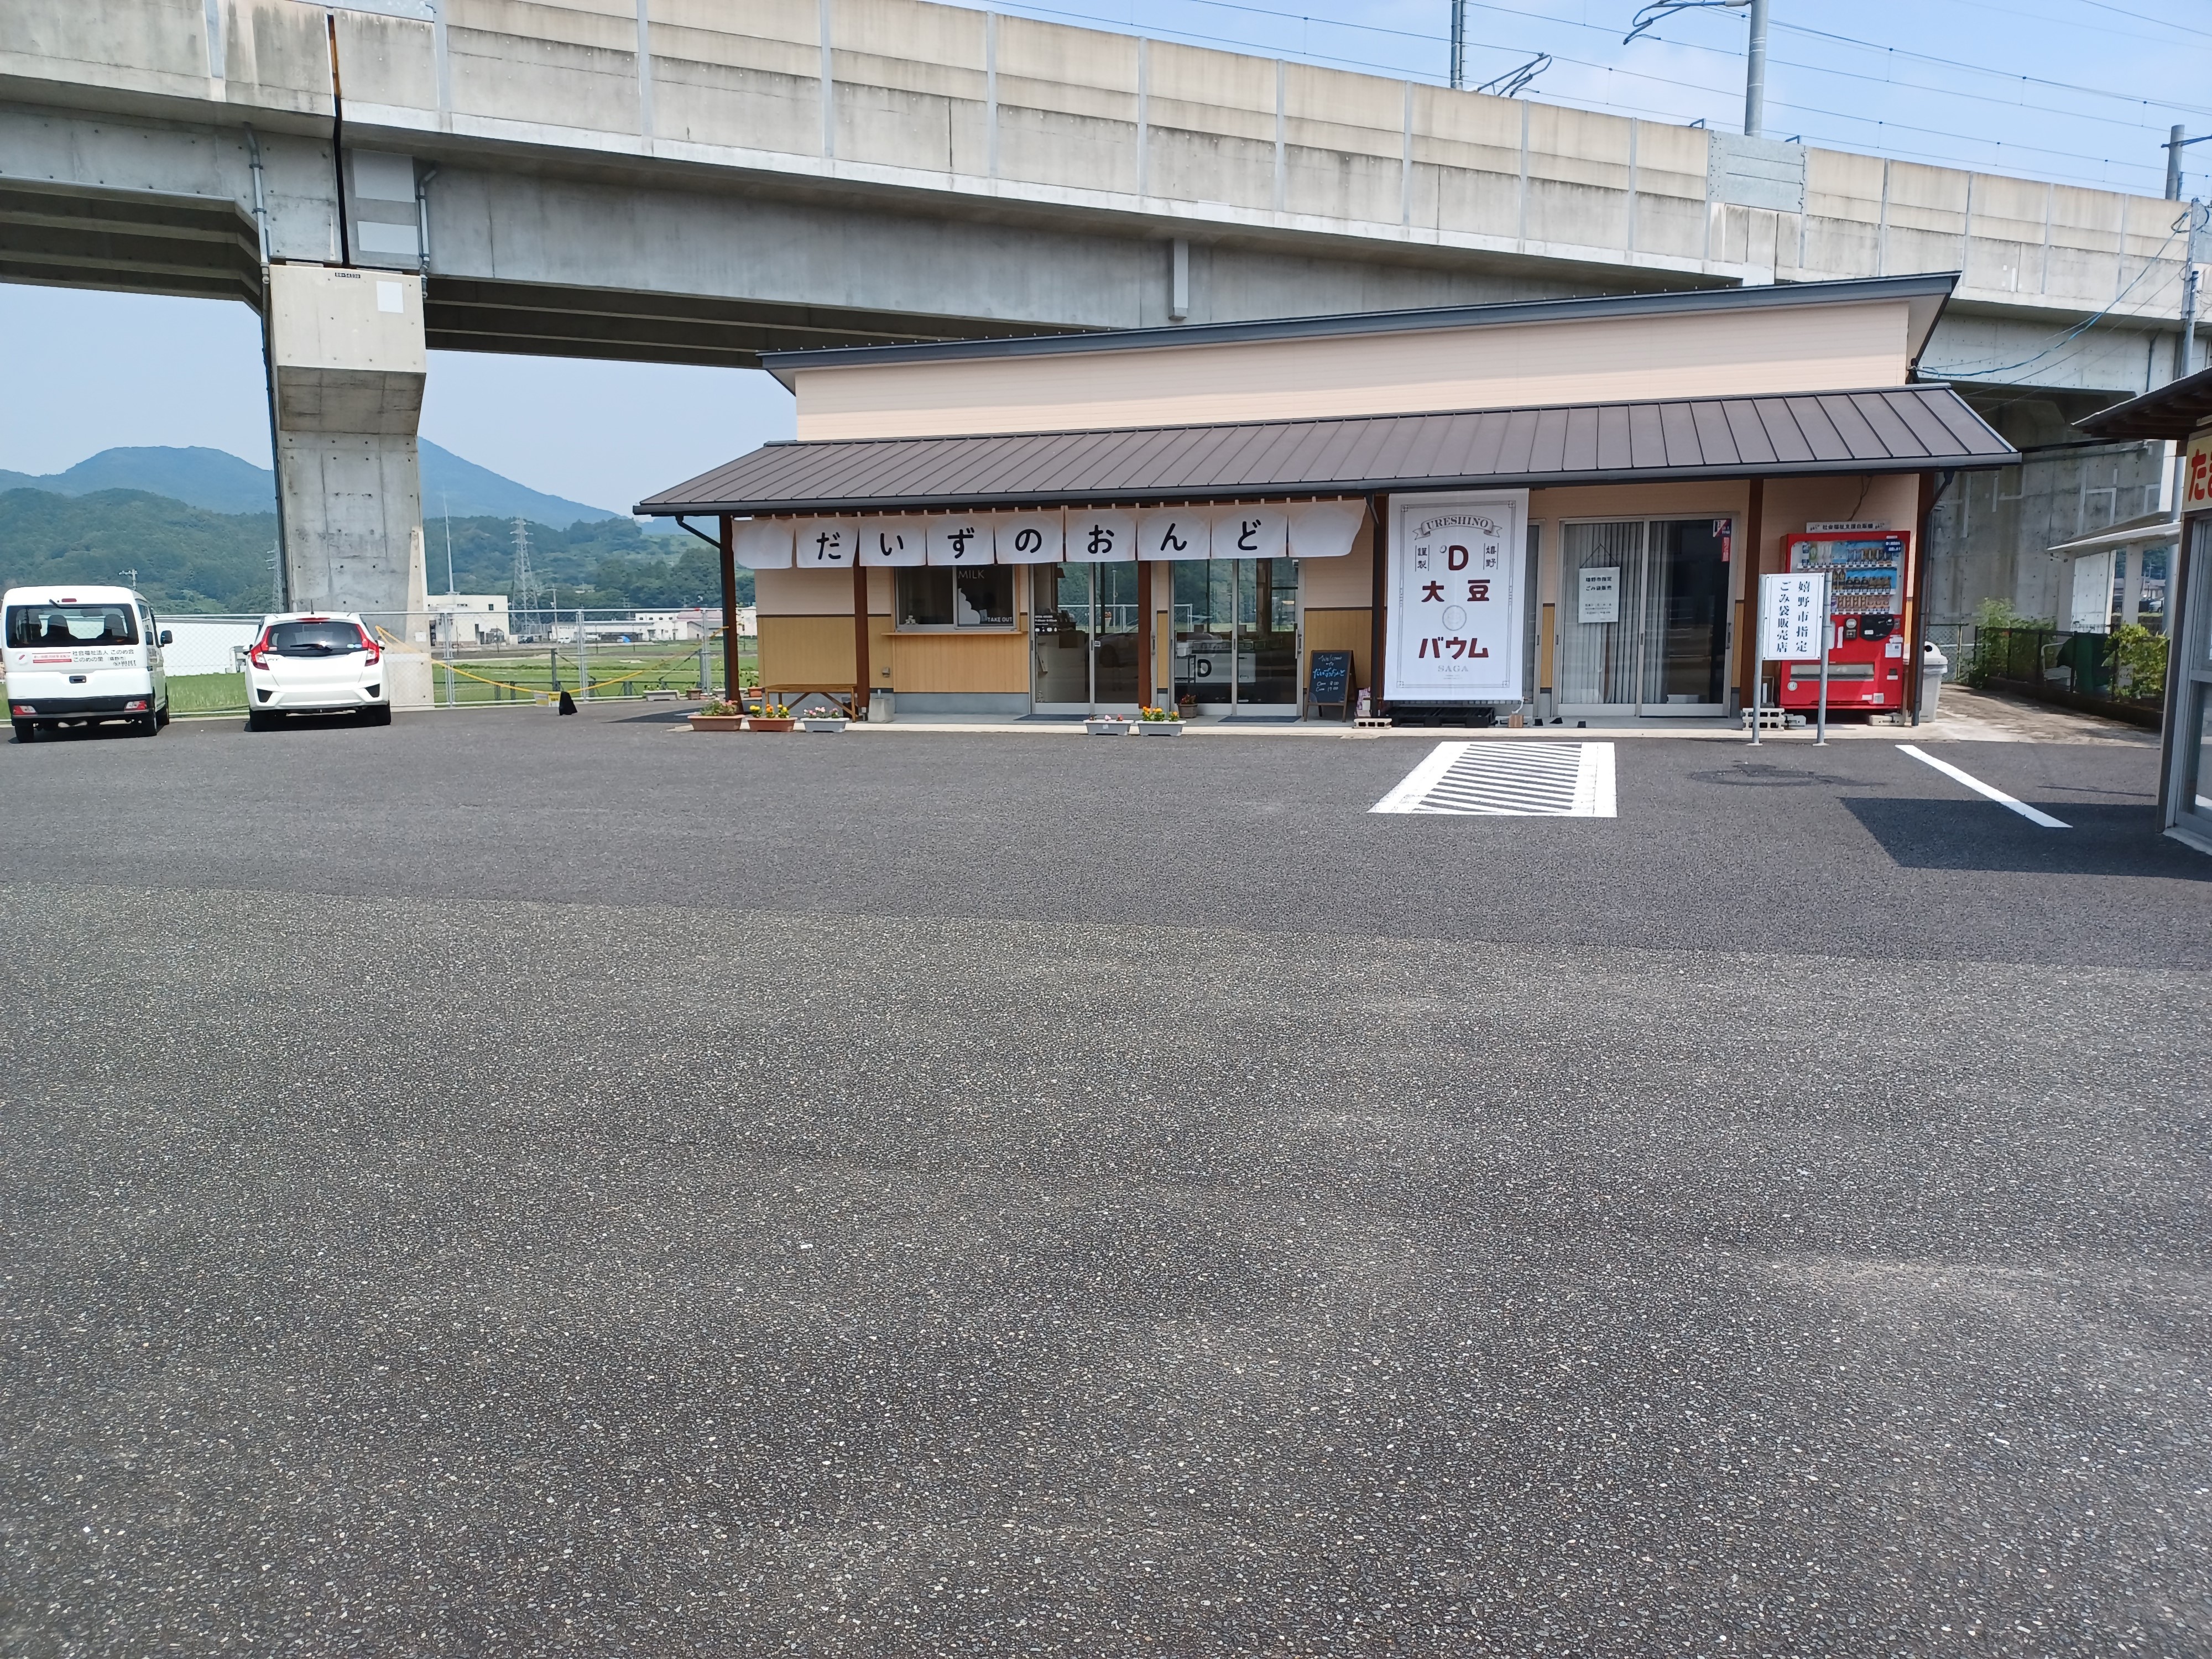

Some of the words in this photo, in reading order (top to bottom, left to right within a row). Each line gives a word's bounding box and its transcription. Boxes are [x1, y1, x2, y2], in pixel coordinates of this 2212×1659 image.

[2188, 448, 2212, 503] た
[816, 519, 1261, 560] だいずのおんど
[1426, 517, 1489, 530] URESHINO
[1485, 545, 1496, 568] 嬉野
[958, 570, 984, 579] MILK
[1776, 581, 1791, 653] ごみ袋販売店
[1796, 581, 1810, 652] 嬉野市指定
[1418, 637, 1489, 659] バウム
